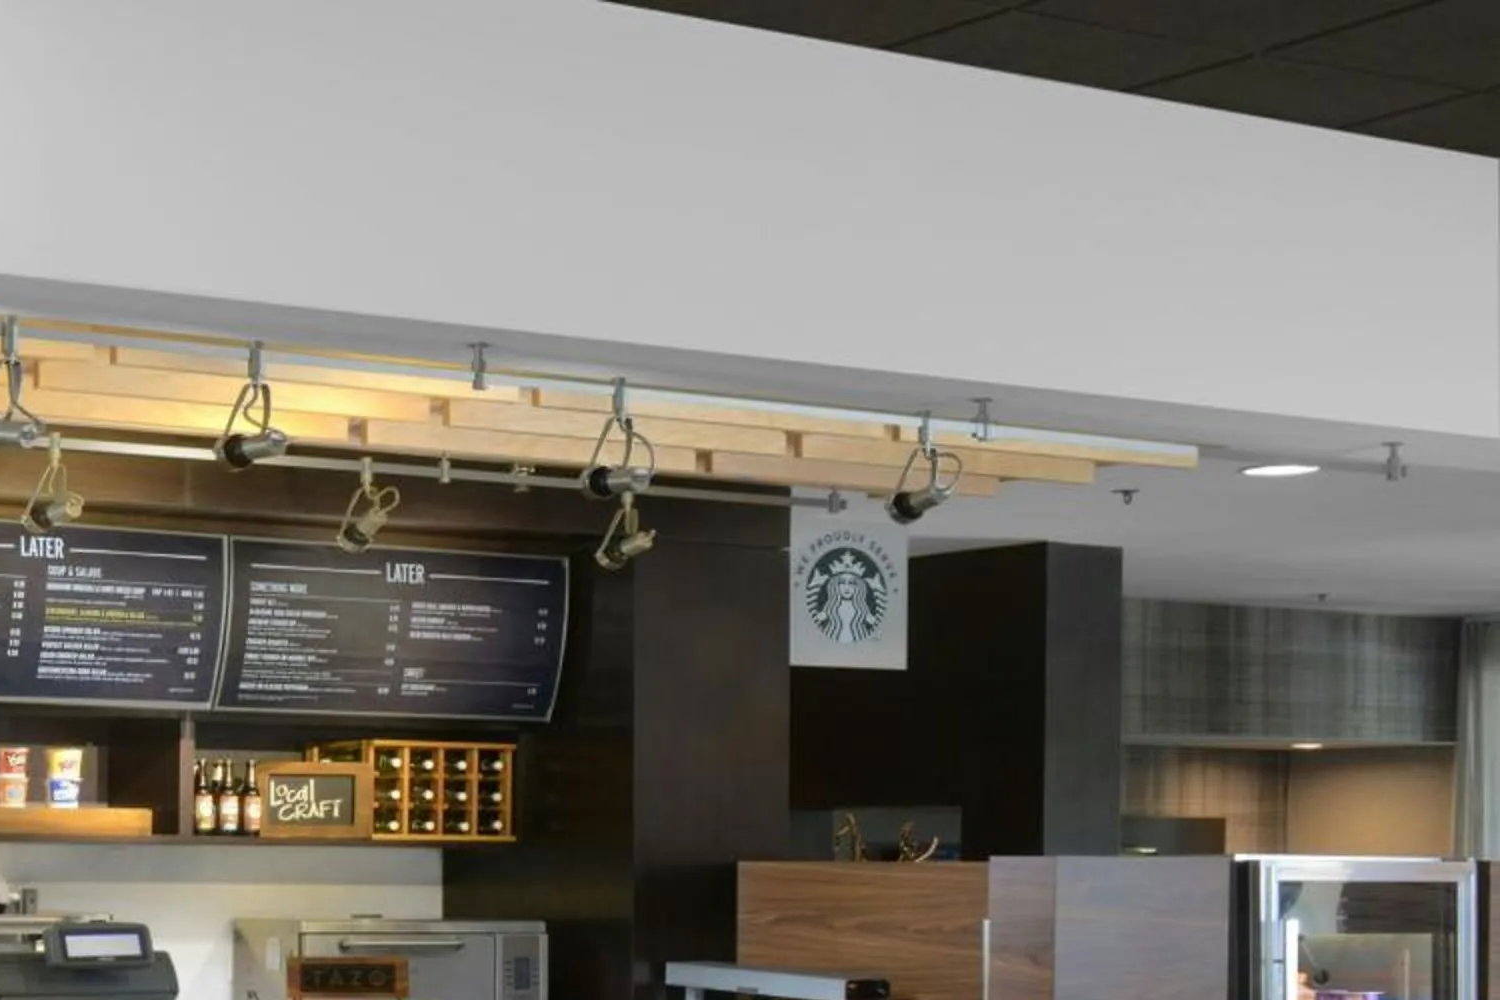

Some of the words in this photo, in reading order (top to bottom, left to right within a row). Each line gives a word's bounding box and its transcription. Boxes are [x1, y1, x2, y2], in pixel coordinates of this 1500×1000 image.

[20, 535, 65, 560] LATER
[386, 562, 425, 584] LATER
[279, 800, 343, 821] CRAFT
[312, 969, 387, 987] TAZO
